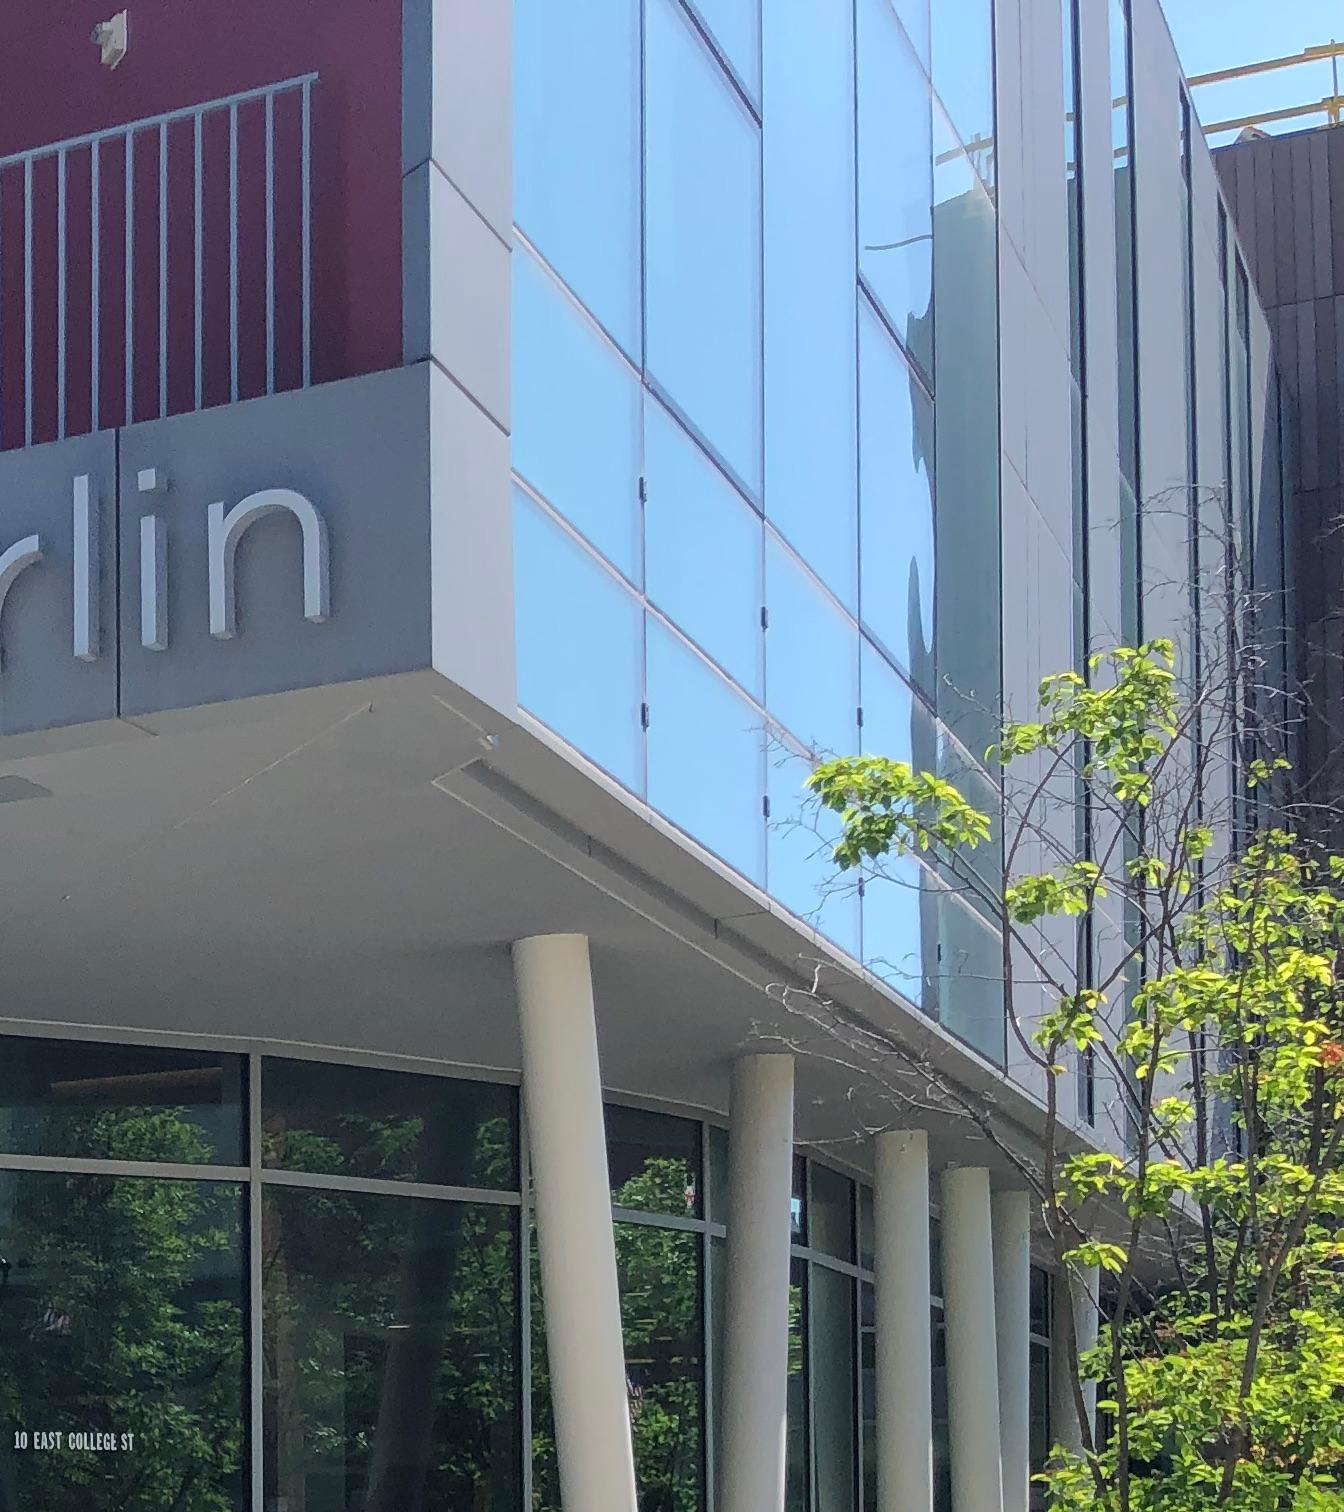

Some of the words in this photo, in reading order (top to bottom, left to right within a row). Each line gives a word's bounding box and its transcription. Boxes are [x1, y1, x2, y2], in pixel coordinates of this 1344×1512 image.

[14, 1431, 28, 1450] 10
[33, 1431, 63, 1450] EAST
[68, 1432, 118, 1451] COLLEGE
[120, 1433, 135, 1452] ST
